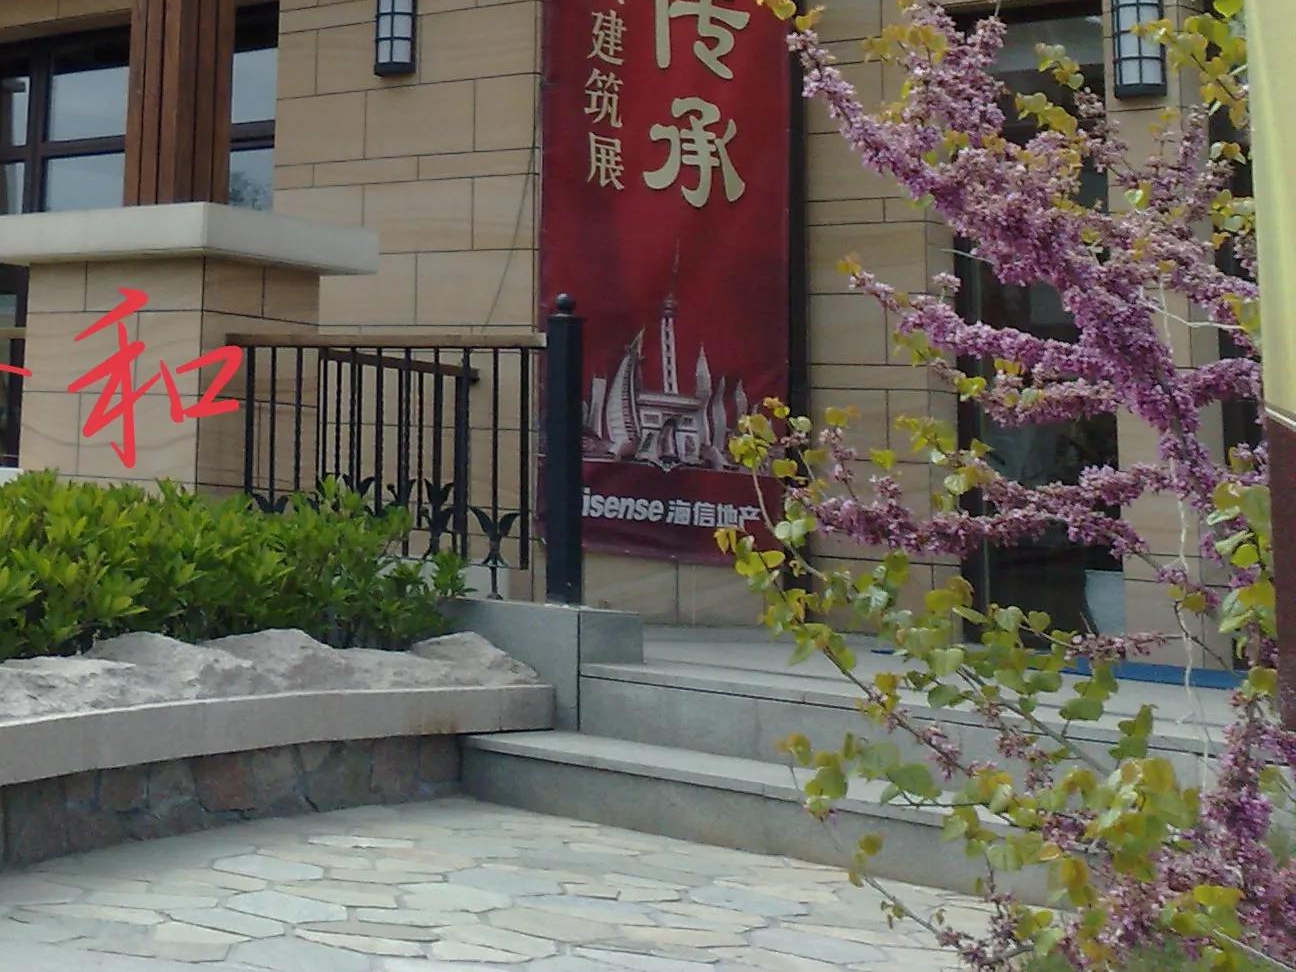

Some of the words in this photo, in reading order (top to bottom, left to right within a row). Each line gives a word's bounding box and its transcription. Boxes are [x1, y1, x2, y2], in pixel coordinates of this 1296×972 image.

[581, 487, 664, 522] isense
[666, 499, 761, 531] 海信地产
